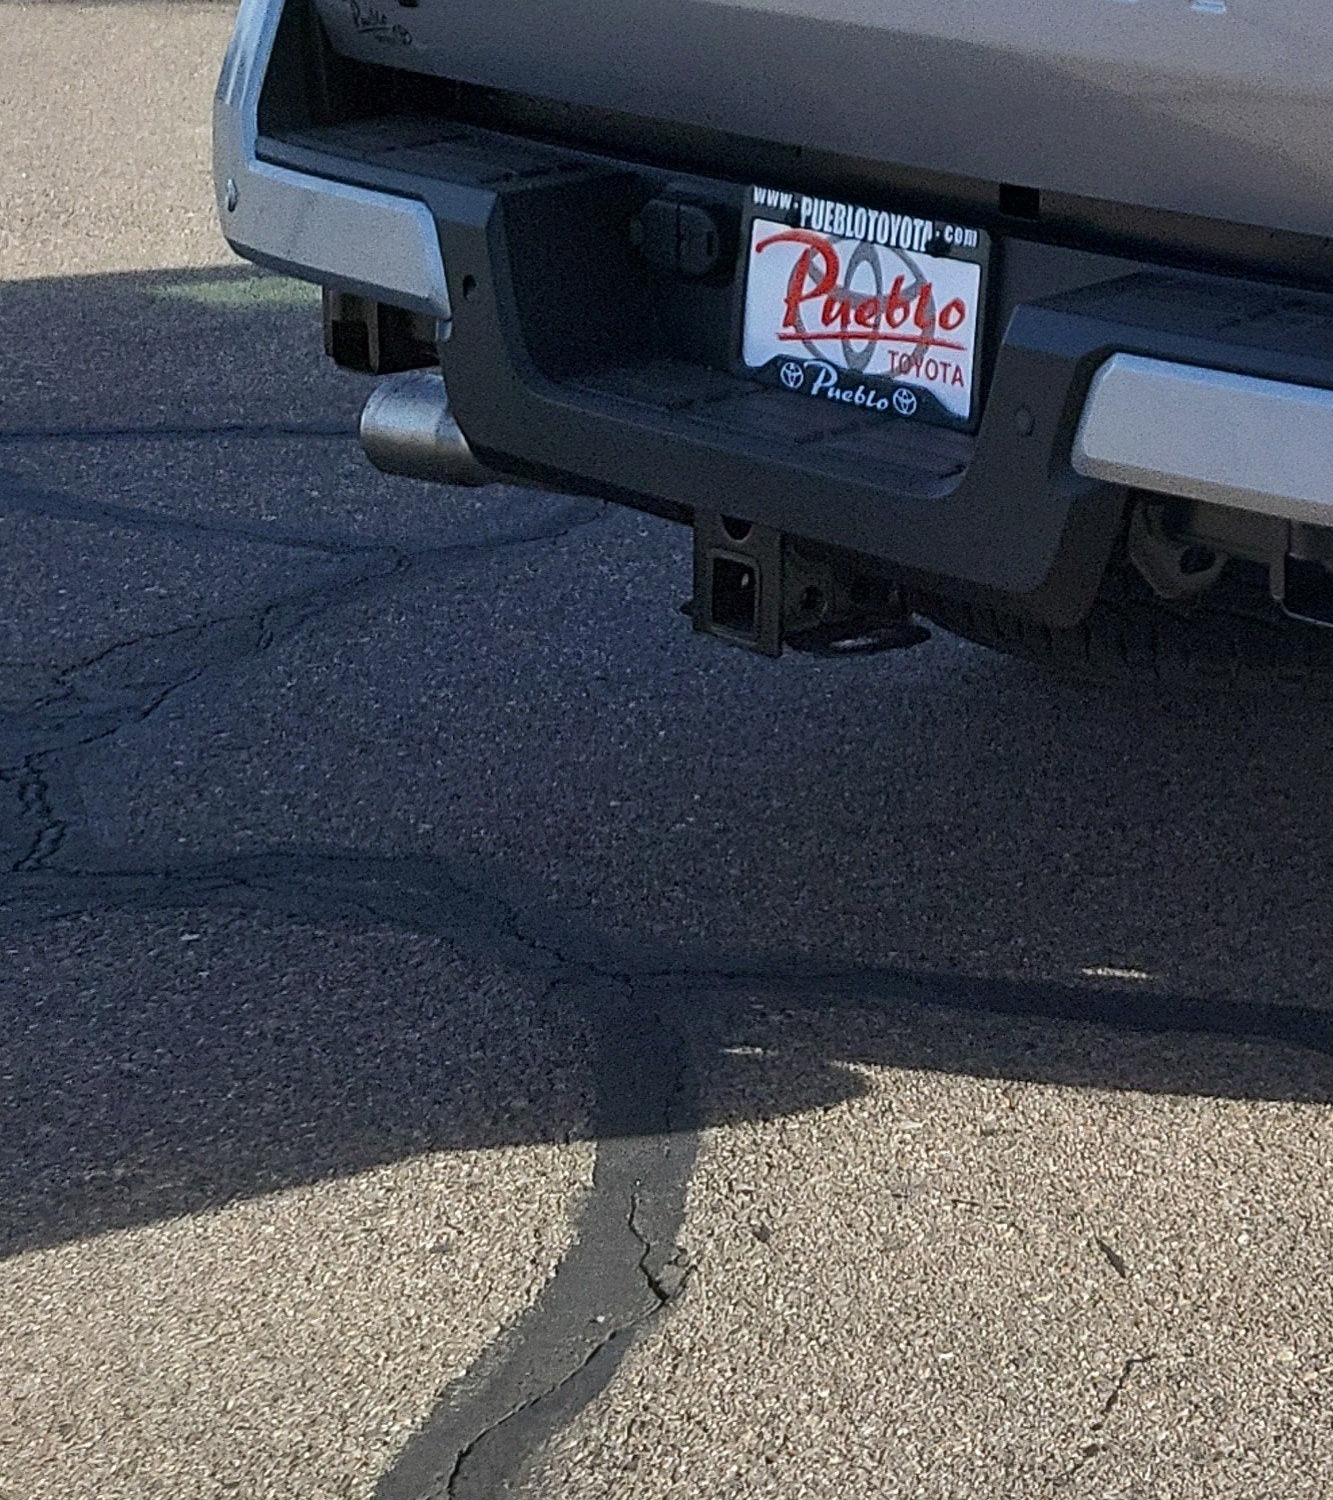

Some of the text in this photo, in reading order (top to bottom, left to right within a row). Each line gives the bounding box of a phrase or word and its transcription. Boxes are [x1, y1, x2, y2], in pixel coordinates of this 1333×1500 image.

[755, 229, 967, 332] Pueblo
[803, 359, 889, 411] Pueblo
[888, 350, 966, 388] TOYOTA
